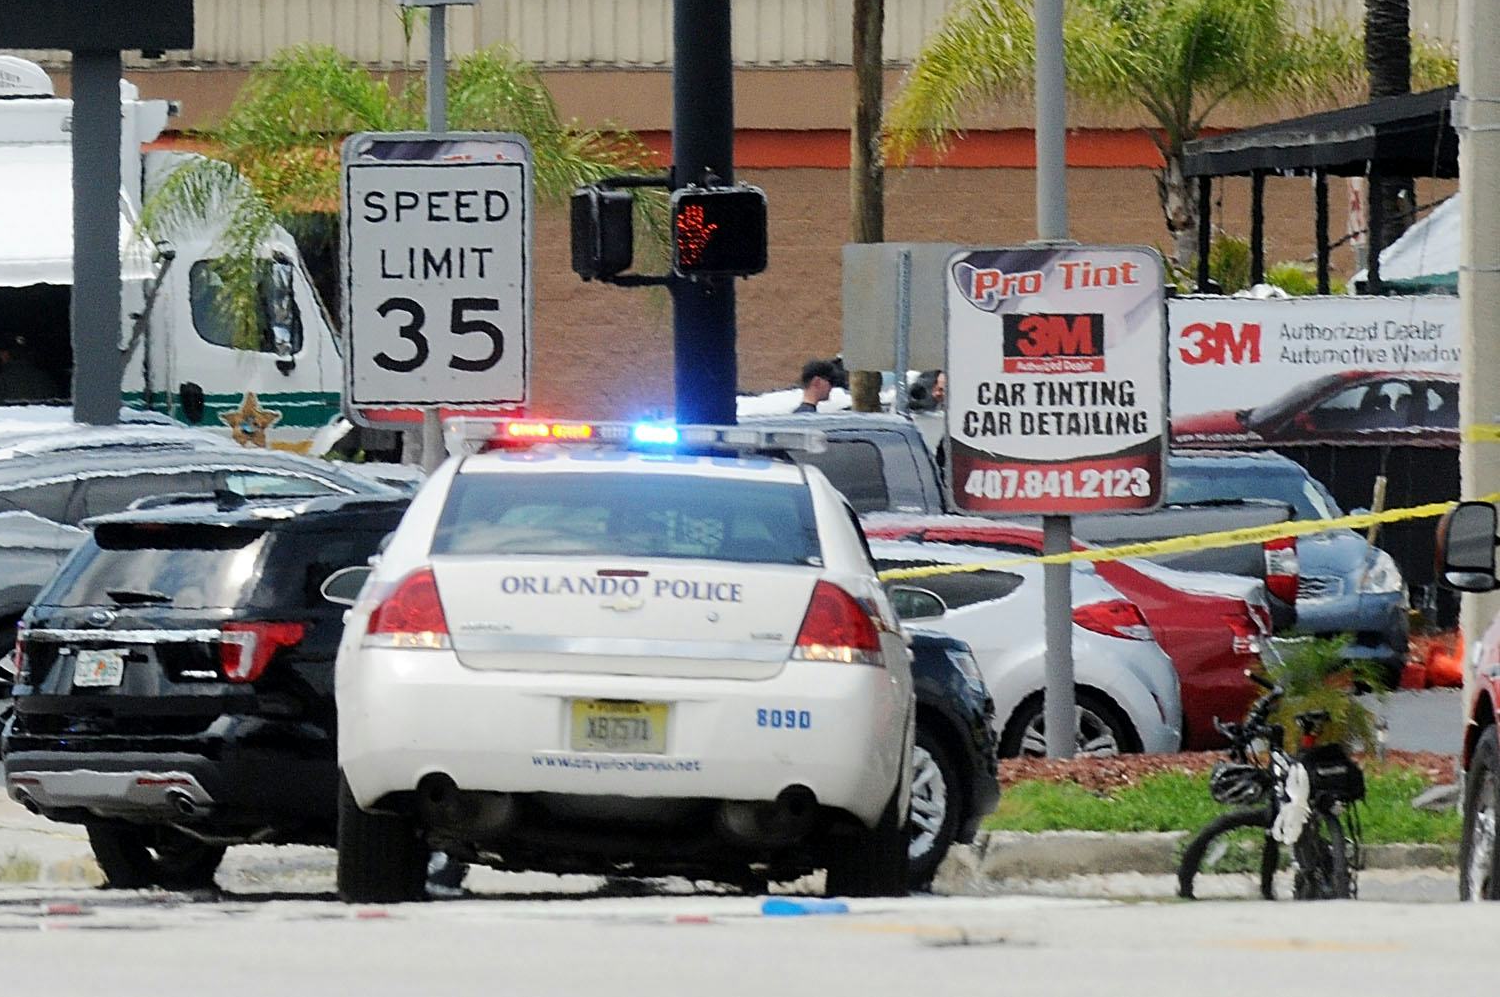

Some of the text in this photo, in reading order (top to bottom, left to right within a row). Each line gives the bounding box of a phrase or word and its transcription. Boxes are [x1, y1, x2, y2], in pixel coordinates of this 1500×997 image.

[363, 189, 510, 223] SPEED
[379, 247, 493, 280] LIMIT
[973, 260, 1141, 301] Pro Tint
[372, 296, 505, 373] 35
[1016, 314, 1097, 357] 3M
[1177, 321, 1263, 365] 3M
[1279, 319, 1445, 342] Authorized Dealer
[1279, 344, 1389, 365] Automotive
[977, 379, 1136, 408] CAR TINTING
[962, 410, 1149, 438] CAR DETAILING
[963, 467, 1152, 500] 407.841.2123
[499, 575, 744, 603] ORLANDO POLICE
[756, 708, 812, 729] 8090
